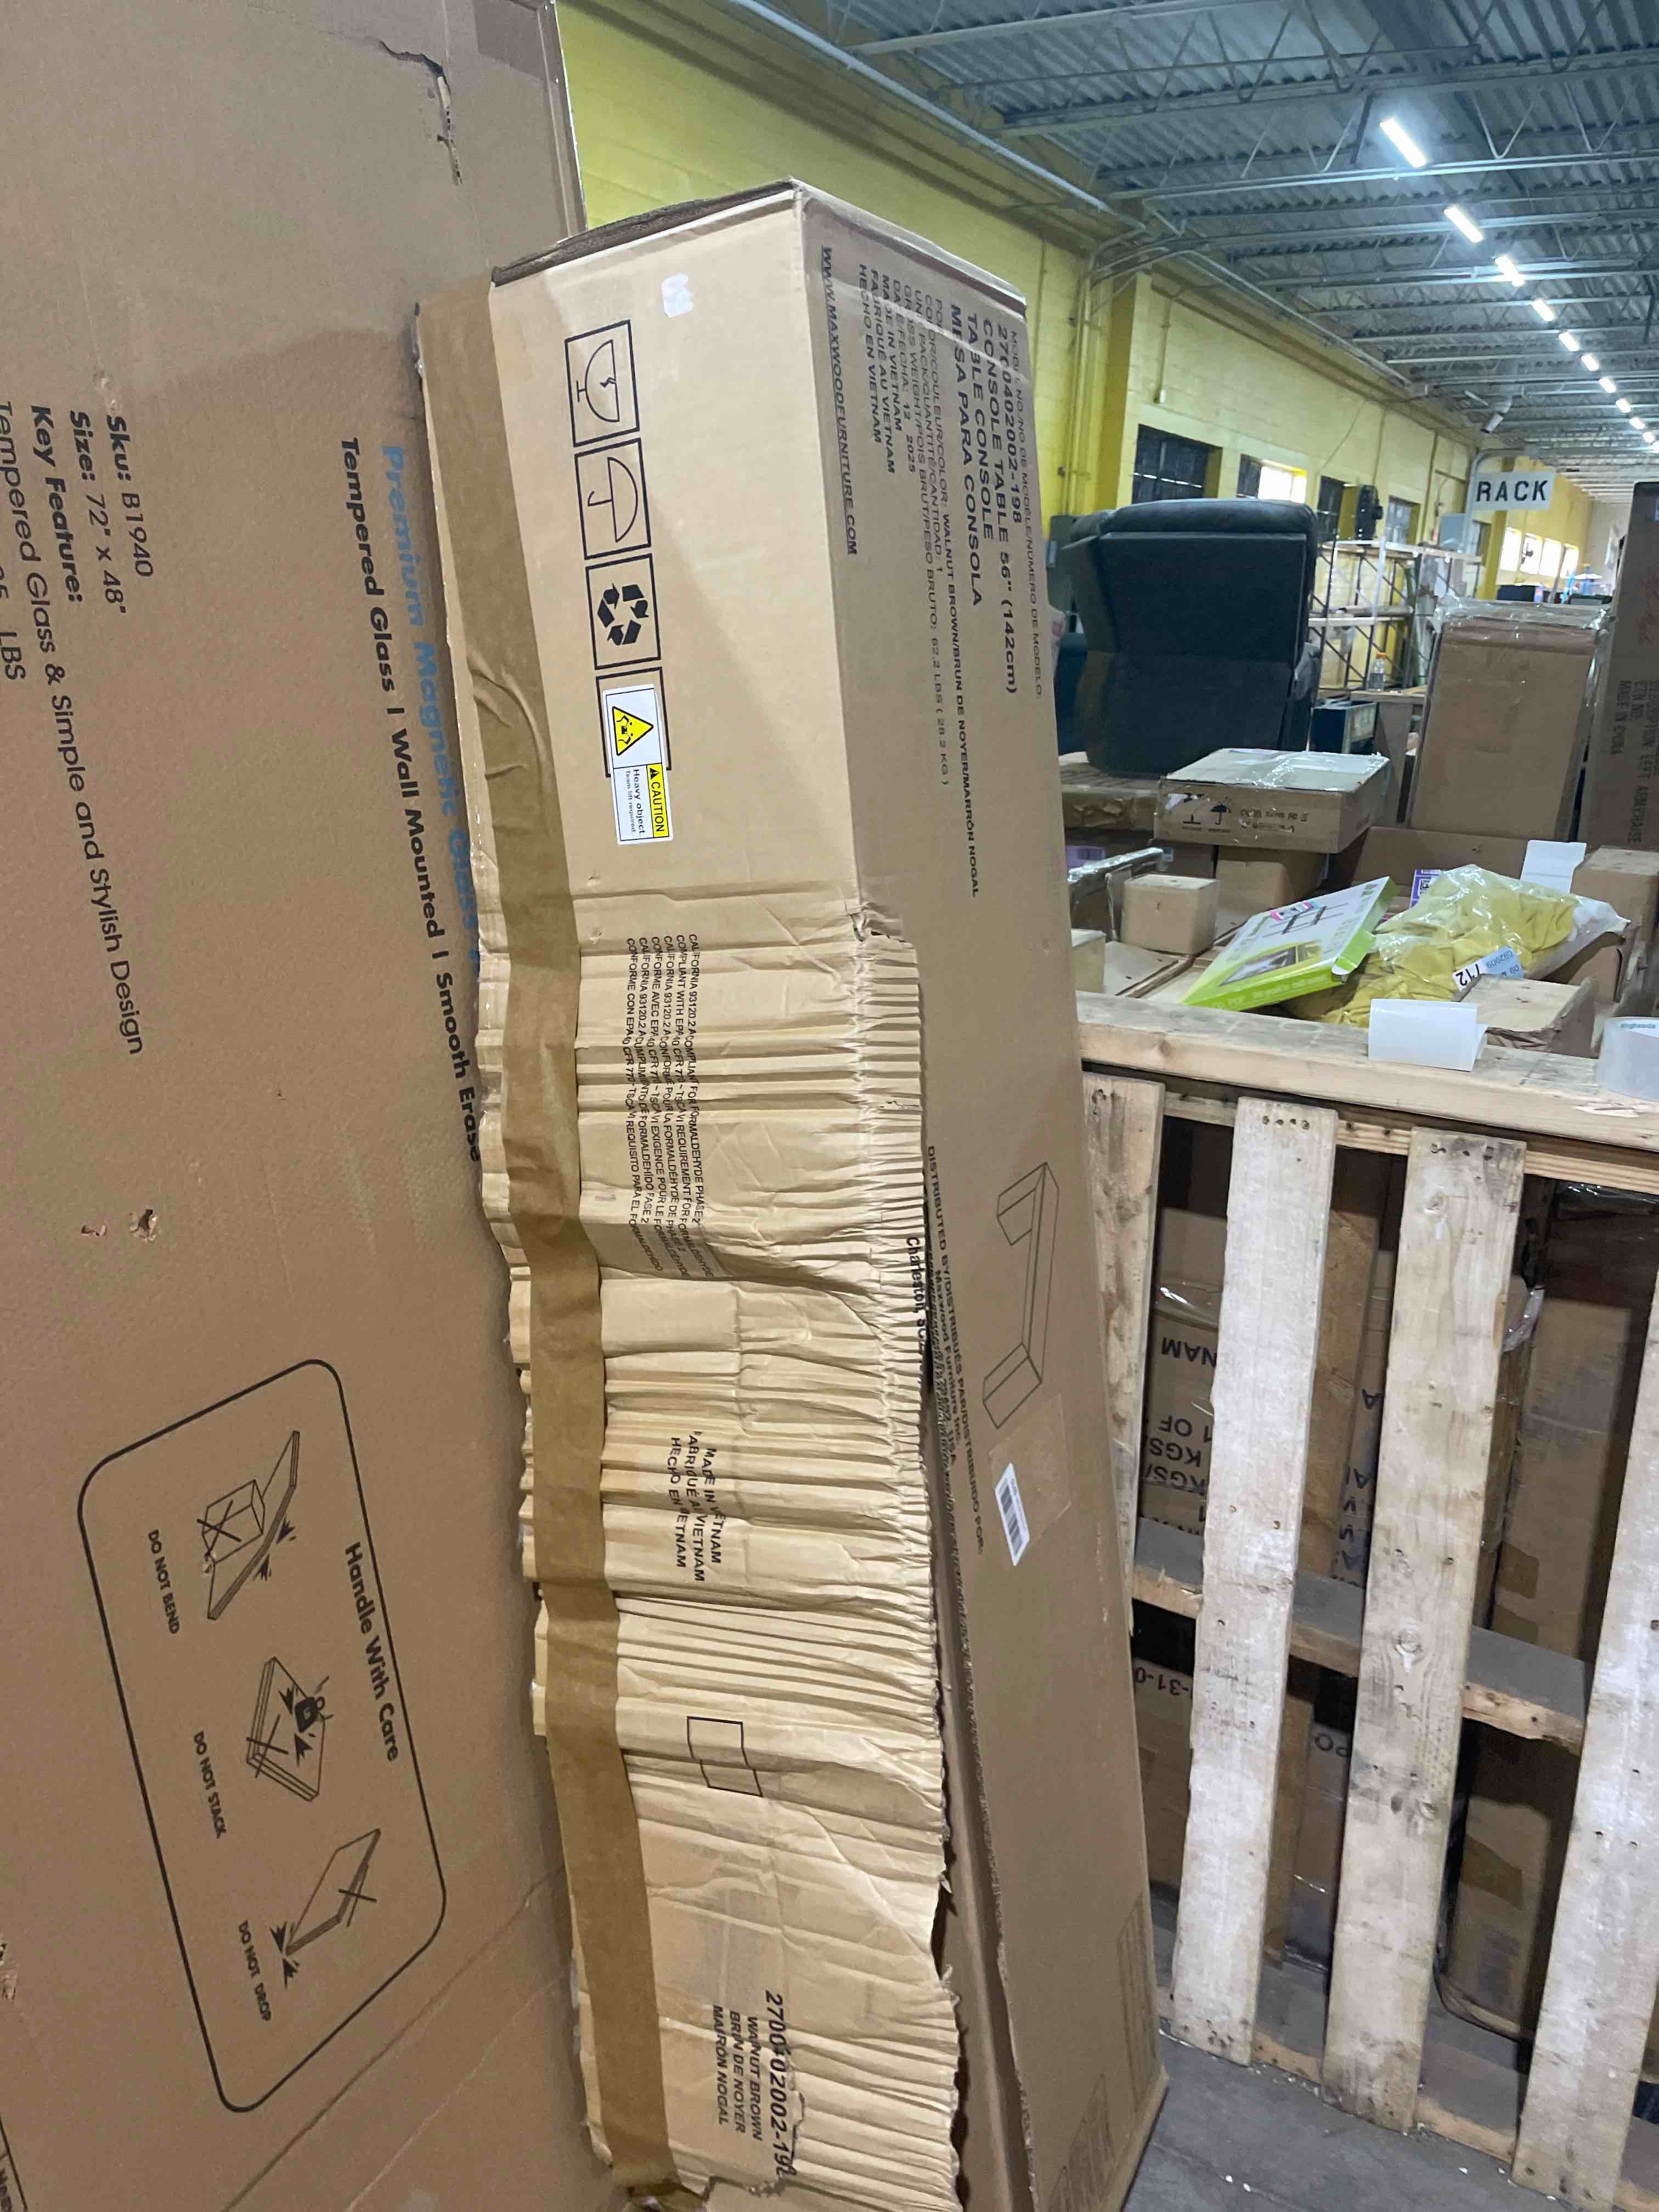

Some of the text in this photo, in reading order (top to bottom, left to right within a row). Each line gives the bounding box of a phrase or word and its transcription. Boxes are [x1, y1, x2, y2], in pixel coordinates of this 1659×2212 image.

[859, 263, 882, 443] HECHO EN VIETNAM
[879, 364, 888, 391] AU
[822, 246, 857, 555] WWW.MAXWOODFURNITURE.COM
[887, 331, 902, 431] IN VIETNAM
[882, 396, 895, 473] VIETNAM
[902, 404, 916, 472] 12 2025
[958, 391, 972, 465] PARA
[967, 313, 994, 540] TABLE CONSOLE
[31, 405, 83, 603] Key Feature:
[70, 410, 127, 614] Size: 72" x 48"
[105, 415, 154, 578] Sku: B1940
[984, 319, 1002, 450] CONSOLE
[994, 460, 1008, 542] TABLE
[1001, 599, 1017, 694] (142cm)
[1476, 480, 1548, 501] RACK
[943, 514, 955, 579] WALNUT
[964, 474, 983, 606] CONSOLA
[380, 445, 424, 626] Premium
[418, 641, 460, 817] Magnetic
[919, 469, 933, 564] BRUT/PESO
[934, 673, 943, 703] LBS
[940, 753, 949, 775] KG
[948, 584, 963, 691] BROWN/BRUN
[1030, 609, 1039, 628] DE
[0, 631, 26, 681] LBS
[0, 401, 146, 1056] Tempered Glass & Simple and Stylish Design
[956, 695, 964, 715] DE
[341, 438, 481, 1163] Tempered Glass Wall Mounted Smooth Erase
[651, 781, 665, 832] CAUTION
[968, 845, 979, 898] NOGAL
[627, 938, 638, 991] CONFORME
[639, 937, 651, 992] CALIFORNIA
[651, 936, 663, 990] CONFORME
[664, 935, 675, 991] CALIFORNIA
[676, 935, 688, 989] COMPLIANT
[627, 993, 635, 1014] CON
[638, 993, 647, 1029] 93120.2
[651, 991, 659, 1017] AVEC
[663, 992, 672, 1028] 93120.2
[676, 990, 685, 1015] WITH
[623, 1047, 634, 1065] CFR
[648, 1049, 659, 1069] CFR
[673, 1048, 684, 1067] CFR
[688, 934, 705, 1217] CALIFORNIA 93120.2 FOR FORMALDEHYDE PHASE
[625, 1087, 637, 1111] TSCA
[639, 1103, 650, 1113] DE
[650, 1092, 662, 1114] TSCA
[663, 1087, 674, 1111] POUR
[663, 1113, 674, 1124] LA
[674, 1091, 687, 1113] TSCA
[626, 1121, 639, 1172] REQUISITO
[637, 1115, 654, 1190] FORMALDEHÍDO
[651, 1126, 664, 1175] EXIGENCE
[663, 1125, 679, 1203] FORMALDÉHYDE
[676, 1125, 691, 1195] REQUIREMENT
[630, 1200, 640, 1212] EL
[631, 1174, 642, 1198] PARA
[642, 1193, 654, 1216] FASE
[654, 1205, 664, 1217] LE
[657, 1177, 667, 1203] POUR
[667, 1205, 678, 1217] DE
[681, 1198, 692, 1216] FOR
[906, 1237, 927, 1313] Charleston,
[927, 1146, 947, 1251] DISTRIBUTED
[958, 1378, 979, 1513] PAR/DISTRIBUIDO
[974, 1516, 985, 1555] POR:
[935, 1270, 950, 1342] Maxwood
[945, 1345, 959, 1414] Furniture
[953, 1417, 962, 1446] Inc.
[667, 1437, 682, 1505] HECHO EN
[702, 1448, 718, 1503] MADE IN
[693, 1514, 708, 1582] VIETNAM
[148, 1529, 180, 1634] DO NOT BEND
[345, 1542, 399, 1762] Handle With Care
[194, 1730, 227, 1839] DO NOT STACK
[239, 1920, 252, 1944] DO
[245, 1945, 261, 1978] NOT
[716, 2070, 729, 2125] NOGAL
[733, 2053, 747, 2134] DE NOYER
[749, 2080, 763, 2141] BROWN
